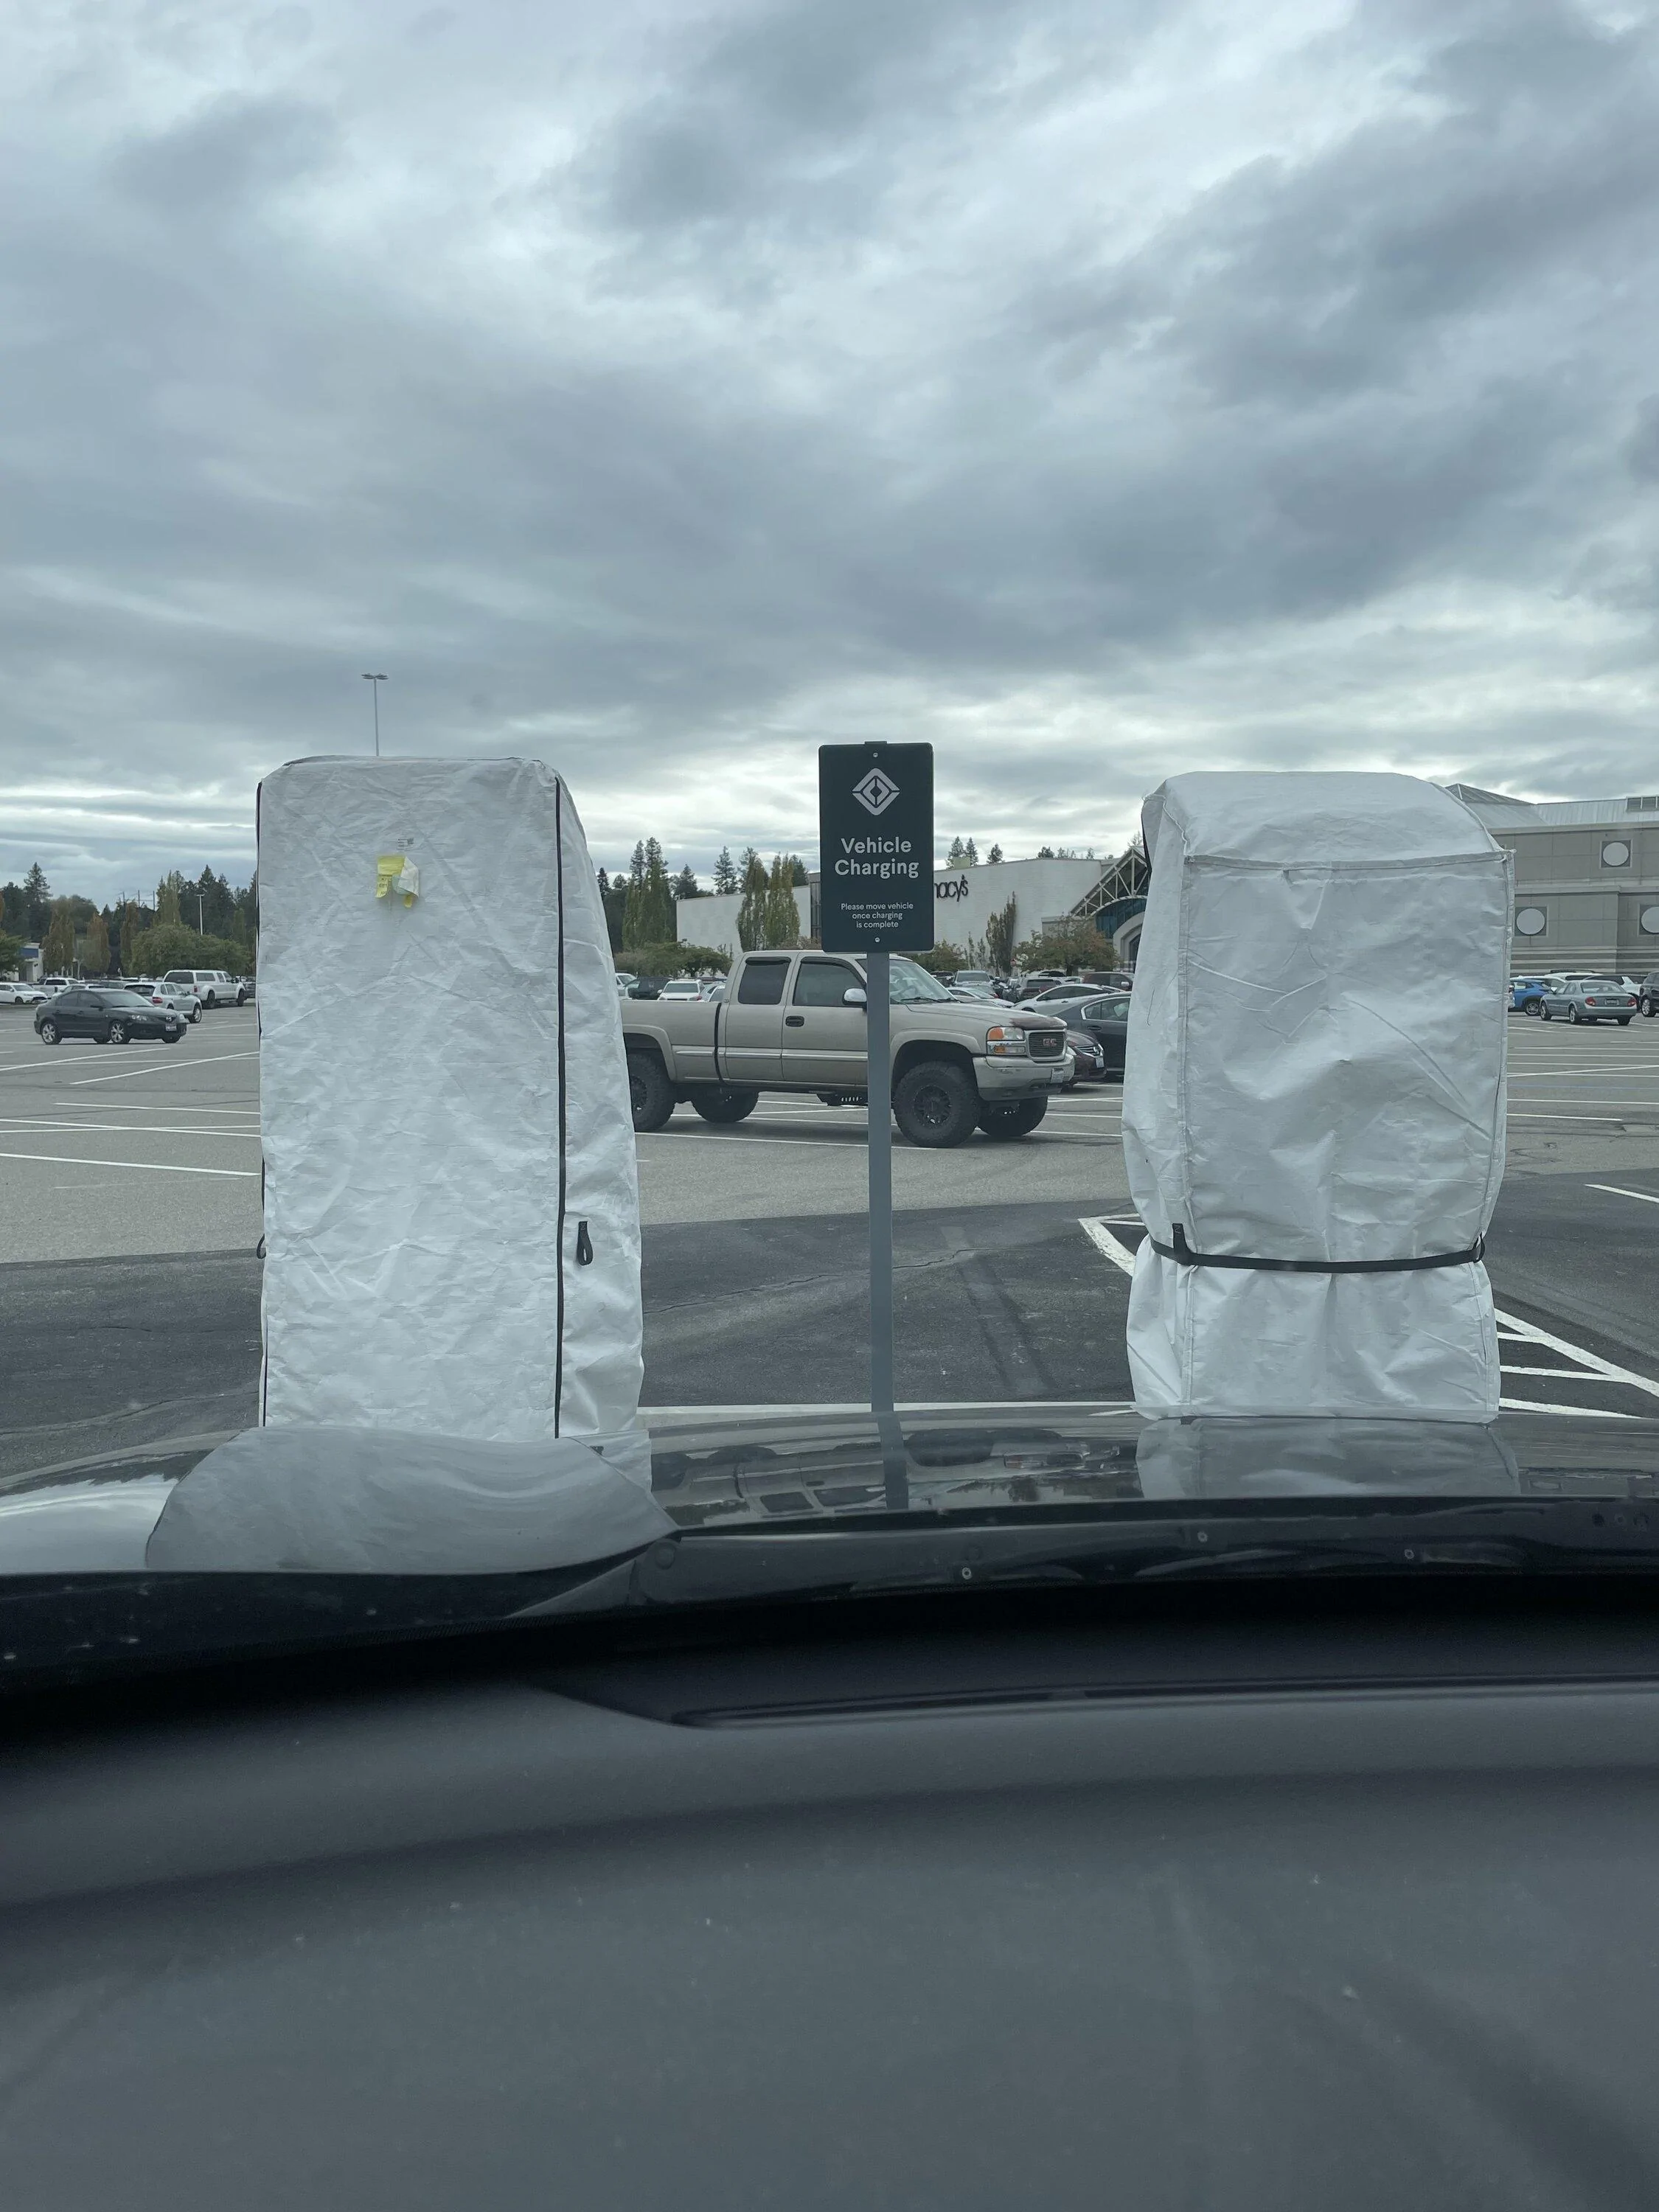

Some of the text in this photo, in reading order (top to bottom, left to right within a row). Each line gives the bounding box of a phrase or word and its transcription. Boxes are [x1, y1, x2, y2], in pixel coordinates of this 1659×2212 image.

[841, 836, 912, 854] Vehicle
[835, 858, 919, 879] Charging
[841, 902, 864, 911] Please
[872, 911, 903, 920] charging
[856, 920, 899, 929] is complete
